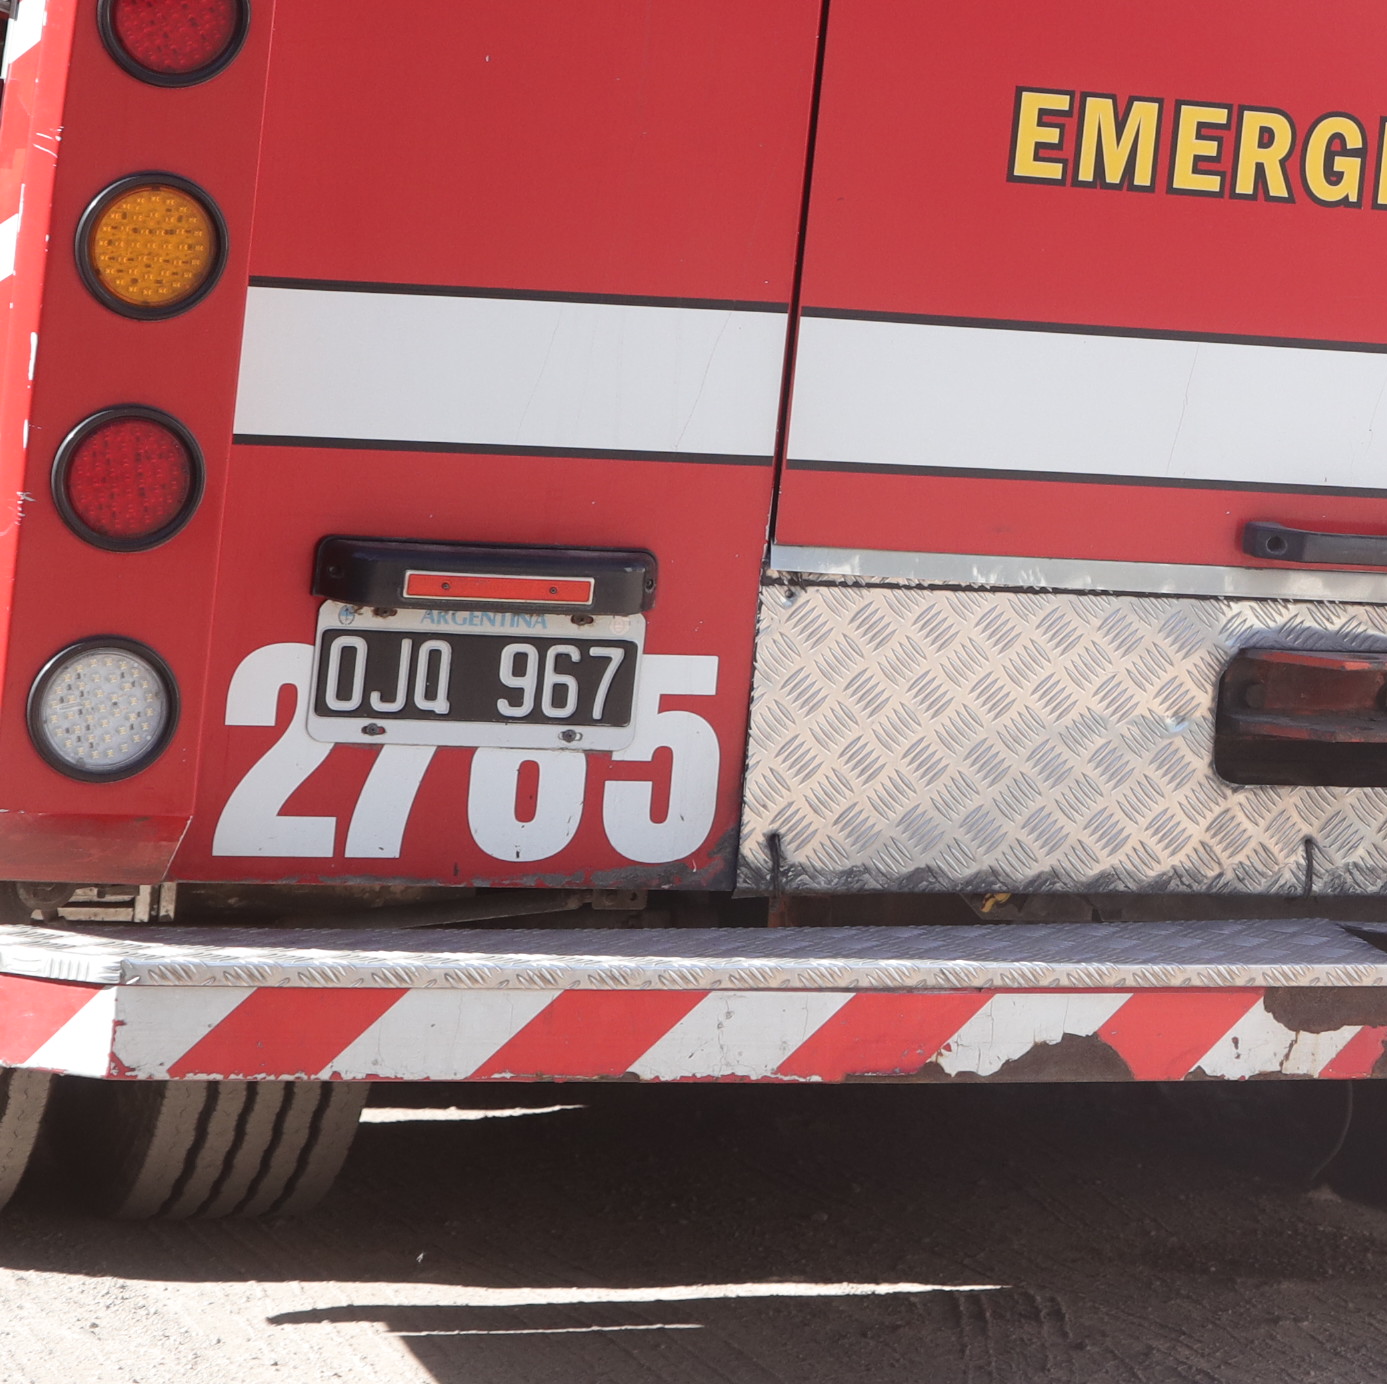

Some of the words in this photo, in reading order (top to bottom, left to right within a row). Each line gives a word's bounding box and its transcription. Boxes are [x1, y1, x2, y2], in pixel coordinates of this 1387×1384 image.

[419, 609, 549, 630] ARGENTINA
[324, 635, 453, 715] OJQ
[497, 642, 625, 721] 967
